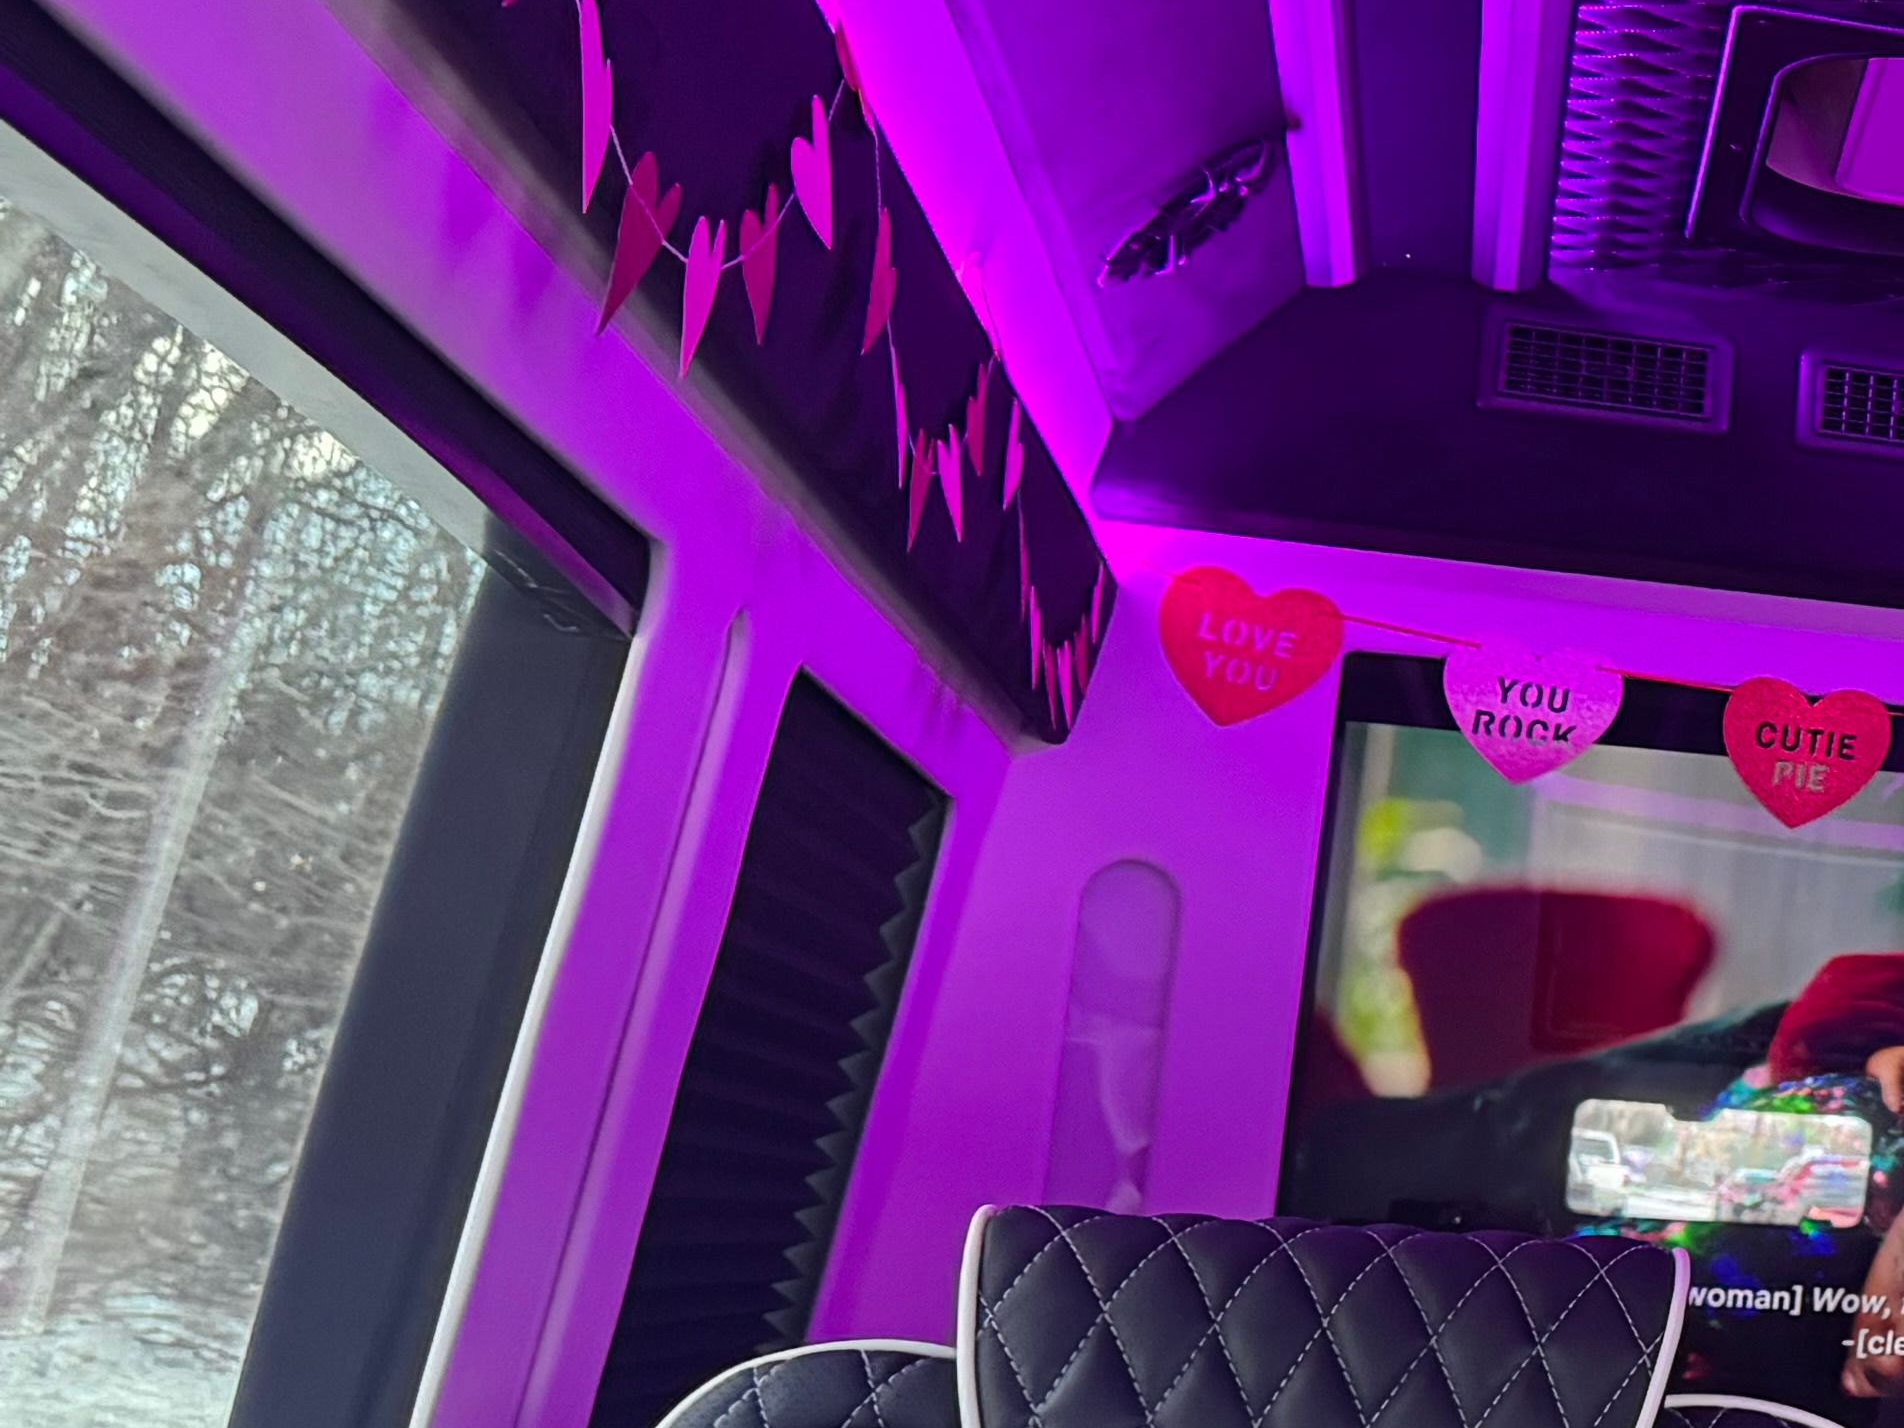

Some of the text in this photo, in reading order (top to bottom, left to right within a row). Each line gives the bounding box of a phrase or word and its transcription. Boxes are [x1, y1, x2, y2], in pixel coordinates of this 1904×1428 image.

[1197, 612, 1298, 659] LOVE
[1202, 650, 1280, 693] YOU
[1498, 675, 1571, 714] YOU
[1471, 708, 1577, 748] ROCK
[1754, 720, 1858, 762] CUTIE
[1771, 760, 1830, 793] PIE
[1812, 1286, 1892, 1320] Wow,
